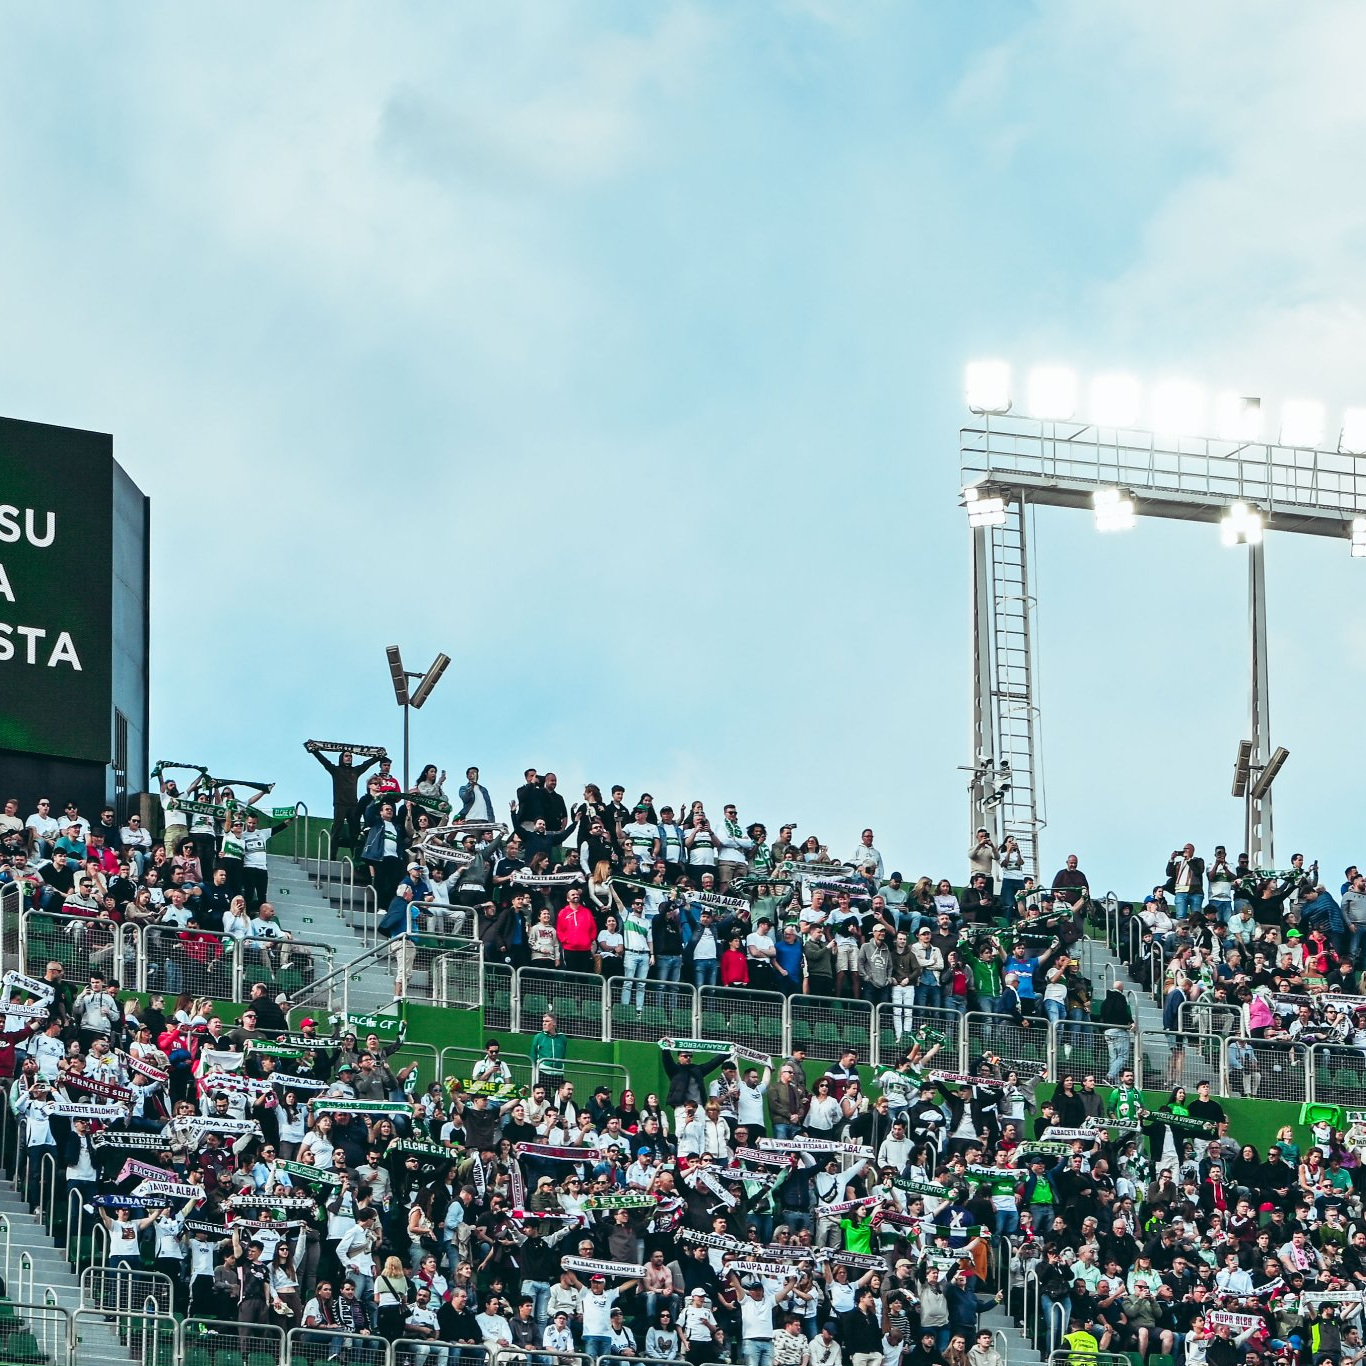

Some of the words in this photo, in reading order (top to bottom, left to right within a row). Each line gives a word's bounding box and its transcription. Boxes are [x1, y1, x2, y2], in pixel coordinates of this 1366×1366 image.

[350, 1016, 376, 1026] ELCHE
[377, 1020, 396, 1030] CF
[67, 1074, 110, 1093] PERNALES
[112, 1088, 130, 1098] SUR
[59, 1105, 88, 1114] ALBACETE
[403, 1141, 428, 1152] ELCHE
[894, 1178, 918, 1192] VOLVER
[919, 1183, 947, 1195] JUNTOS
[112, 1196, 165, 1207] ALBACETE
[573, 1259, 605, 1271] ALBACETE
